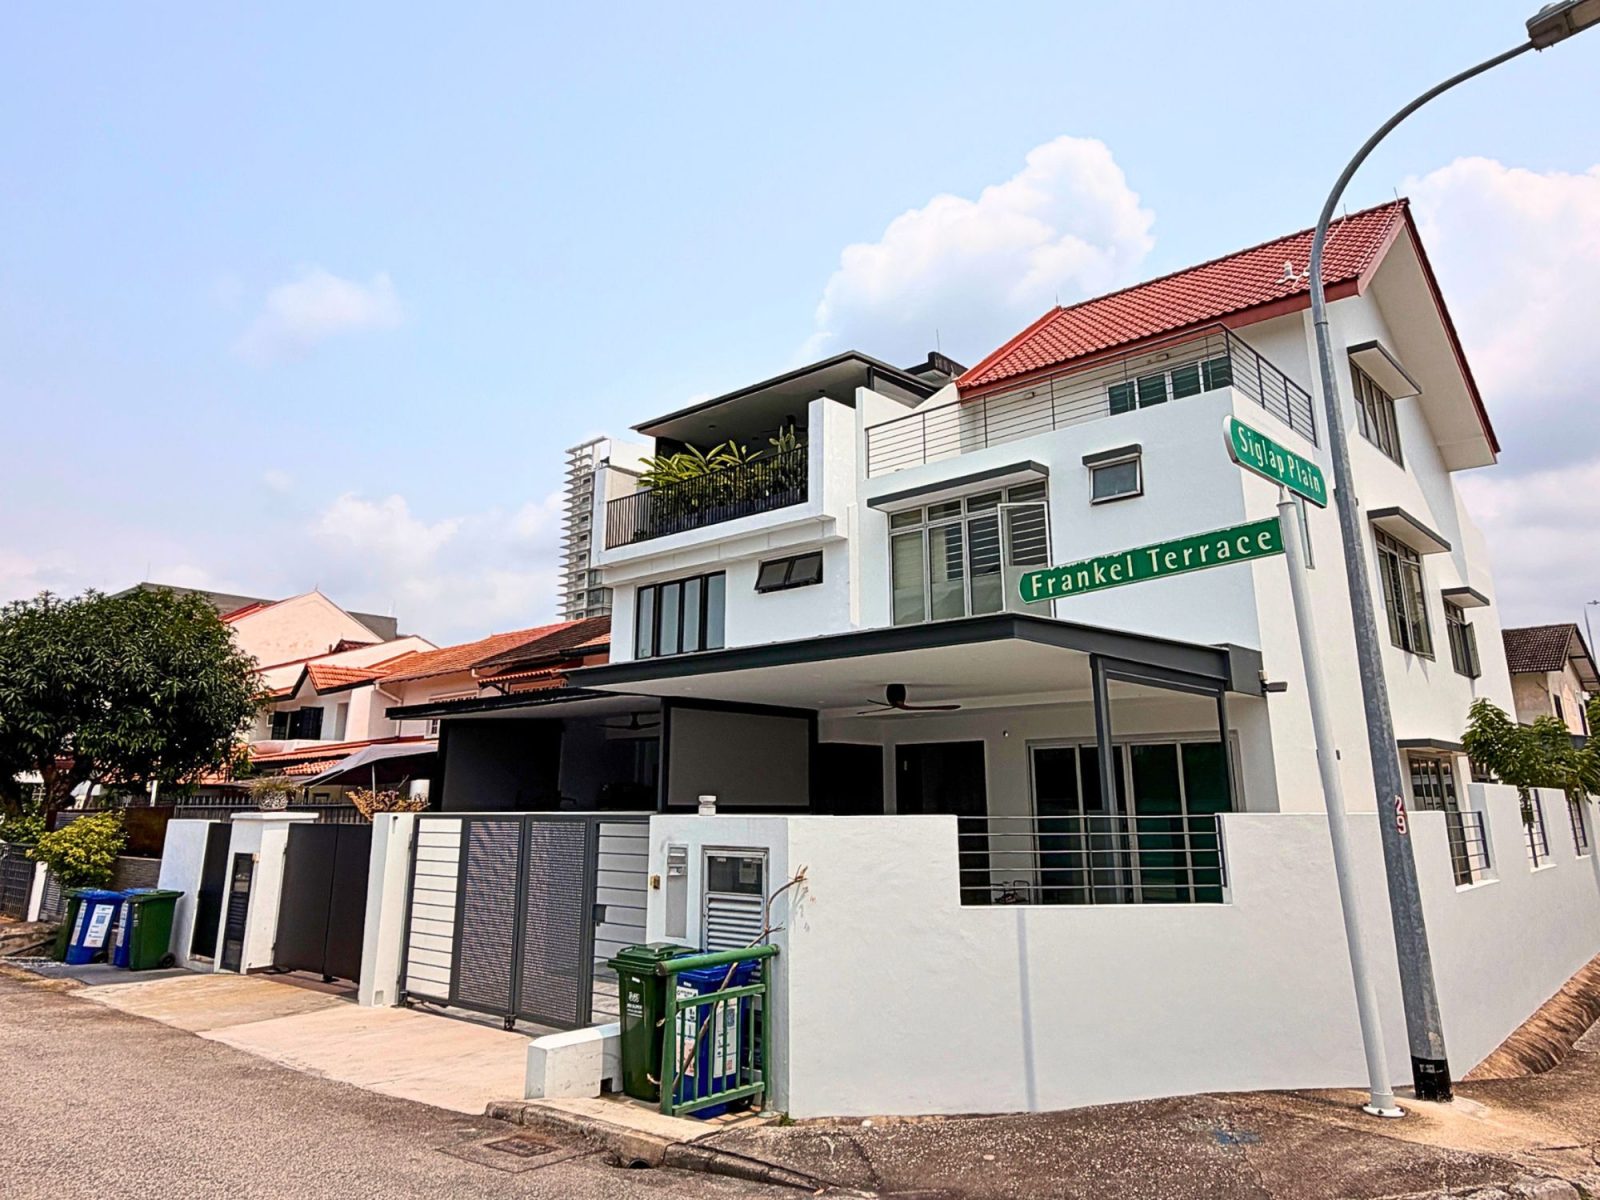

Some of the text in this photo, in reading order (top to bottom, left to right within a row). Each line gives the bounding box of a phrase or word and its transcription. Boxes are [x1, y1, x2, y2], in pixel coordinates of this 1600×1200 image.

[1238, 427, 1320, 493] Siglap Plain
[1032, 531, 1272, 597] Frankel Terrace
[1395, 795, 1407, 834] 29
